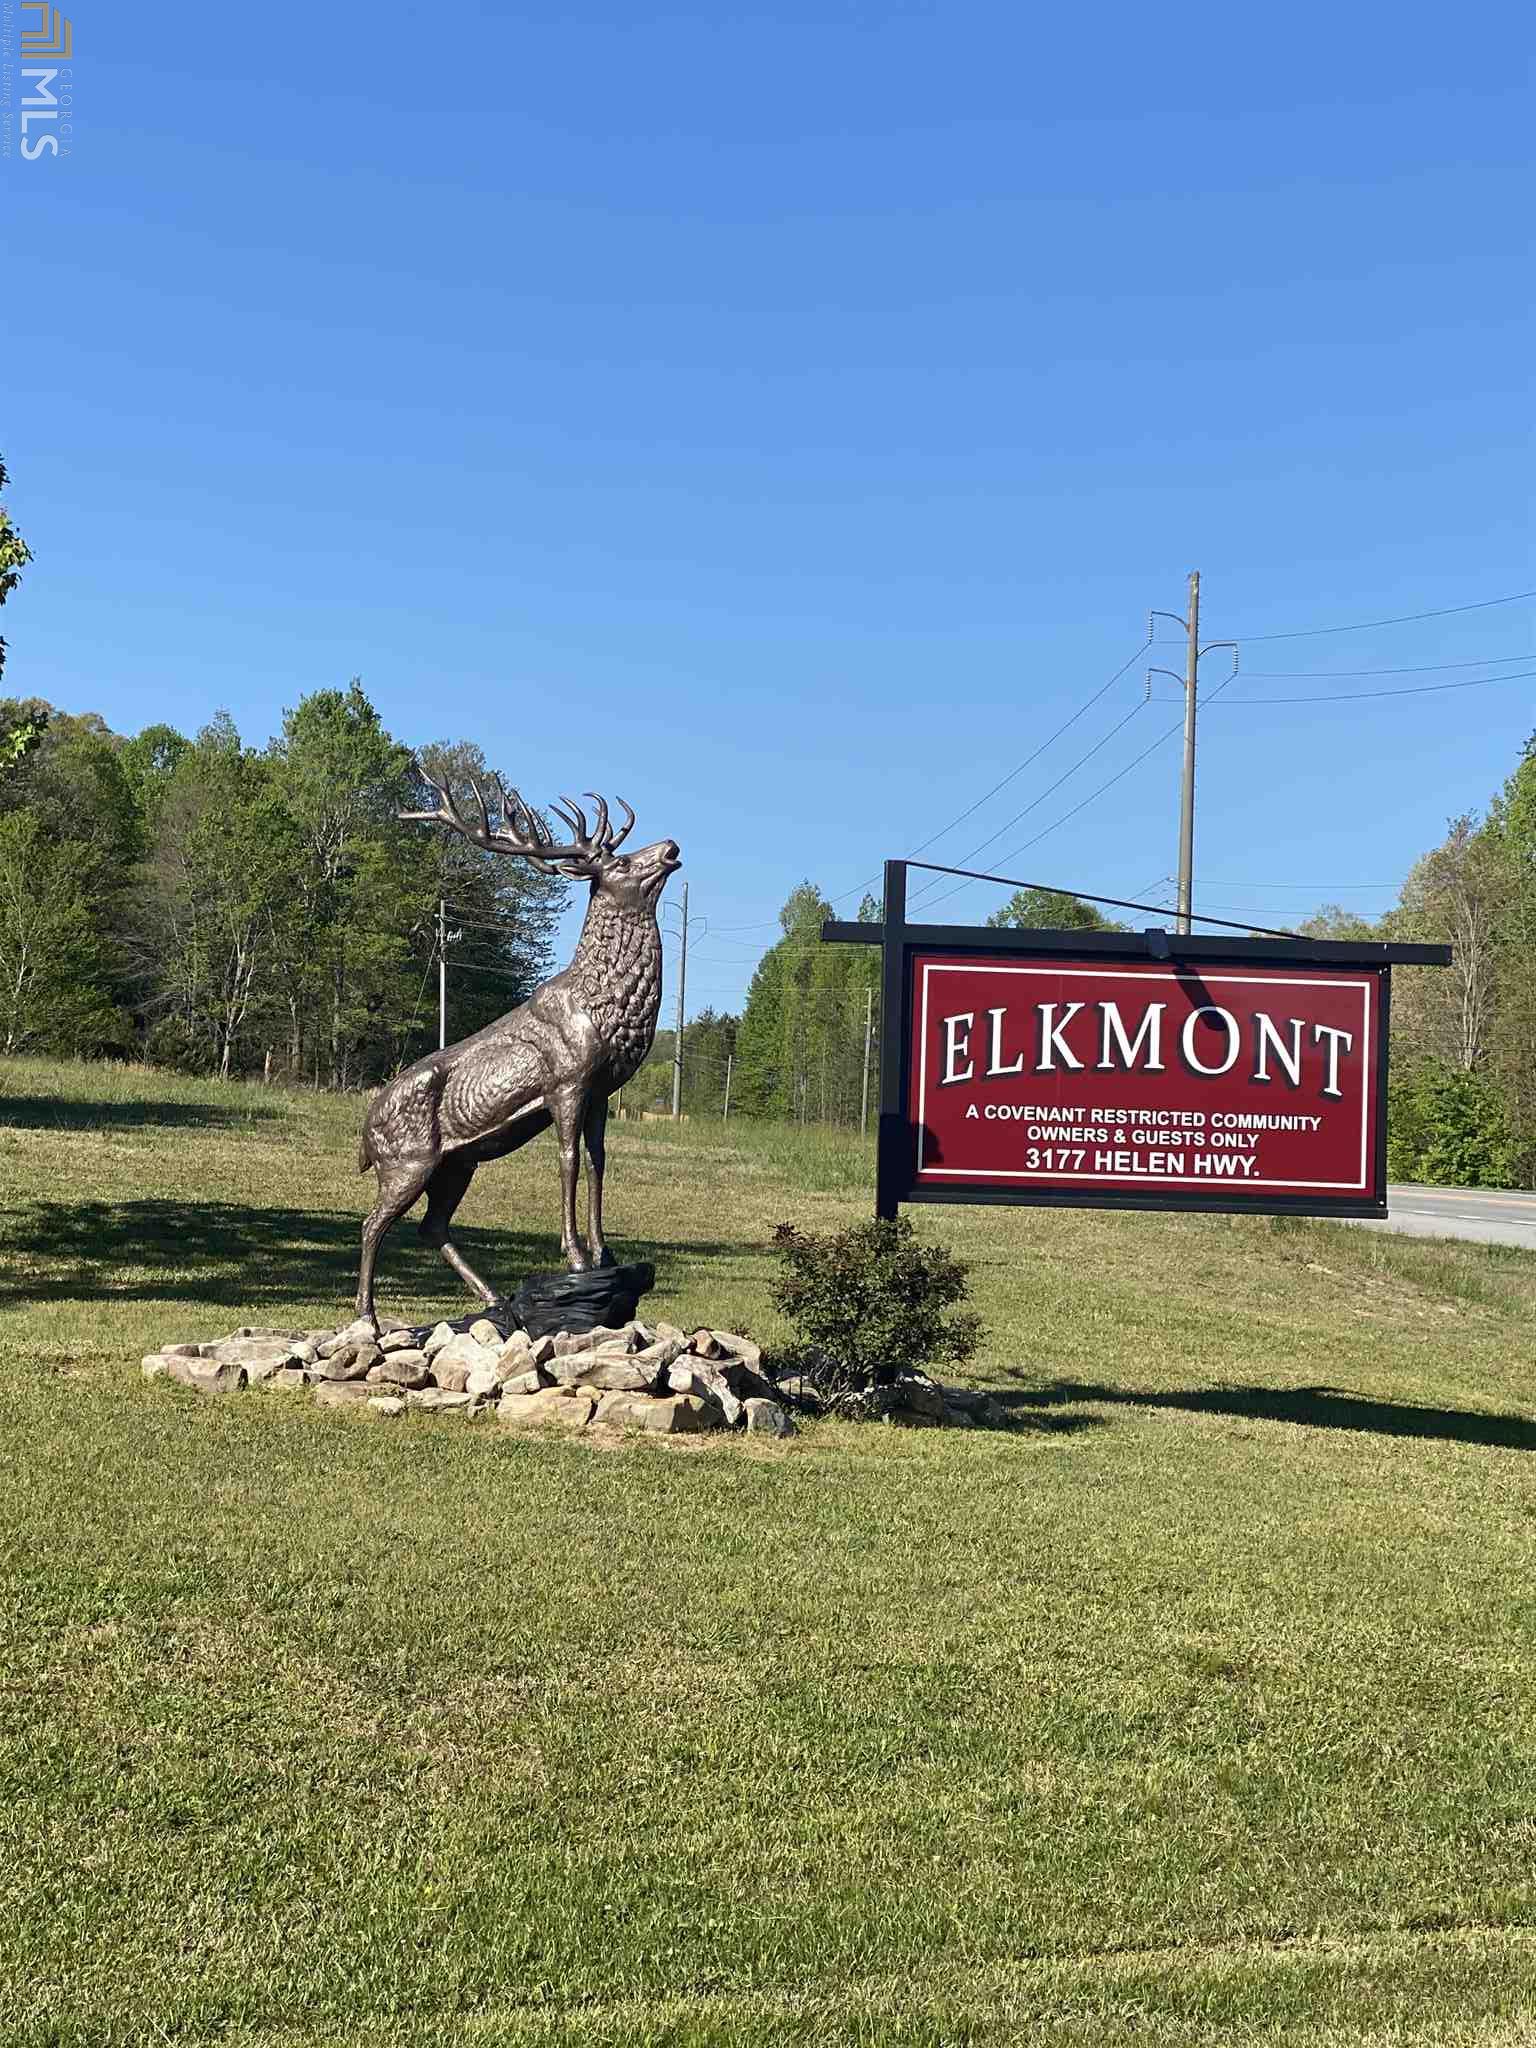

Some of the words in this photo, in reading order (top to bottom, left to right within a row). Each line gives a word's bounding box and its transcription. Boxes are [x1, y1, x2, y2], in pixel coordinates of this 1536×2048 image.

[940, 1001, 1354, 1098] ELKMONT
[965, 1103, 979, 1119] A
[984, 1104, 1087, 1123] COVENANT
[1090, 1108, 1206, 1127] RESTRICTED
[1210, 1112, 1322, 1131] COMMUNITY
[1027, 1125, 1109, 1143] OWNERS
[1113, 1128, 1127, 1144] &
[1131, 1129, 1206, 1147] GUESTS
[1210, 1132, 1260, 1148] ONLY
[1025, 1147, 1086, 1170] 3177
[1094, 1150, 1185, 1174] HELEN
[1194, 1153, 1260, 1177] HWY.
